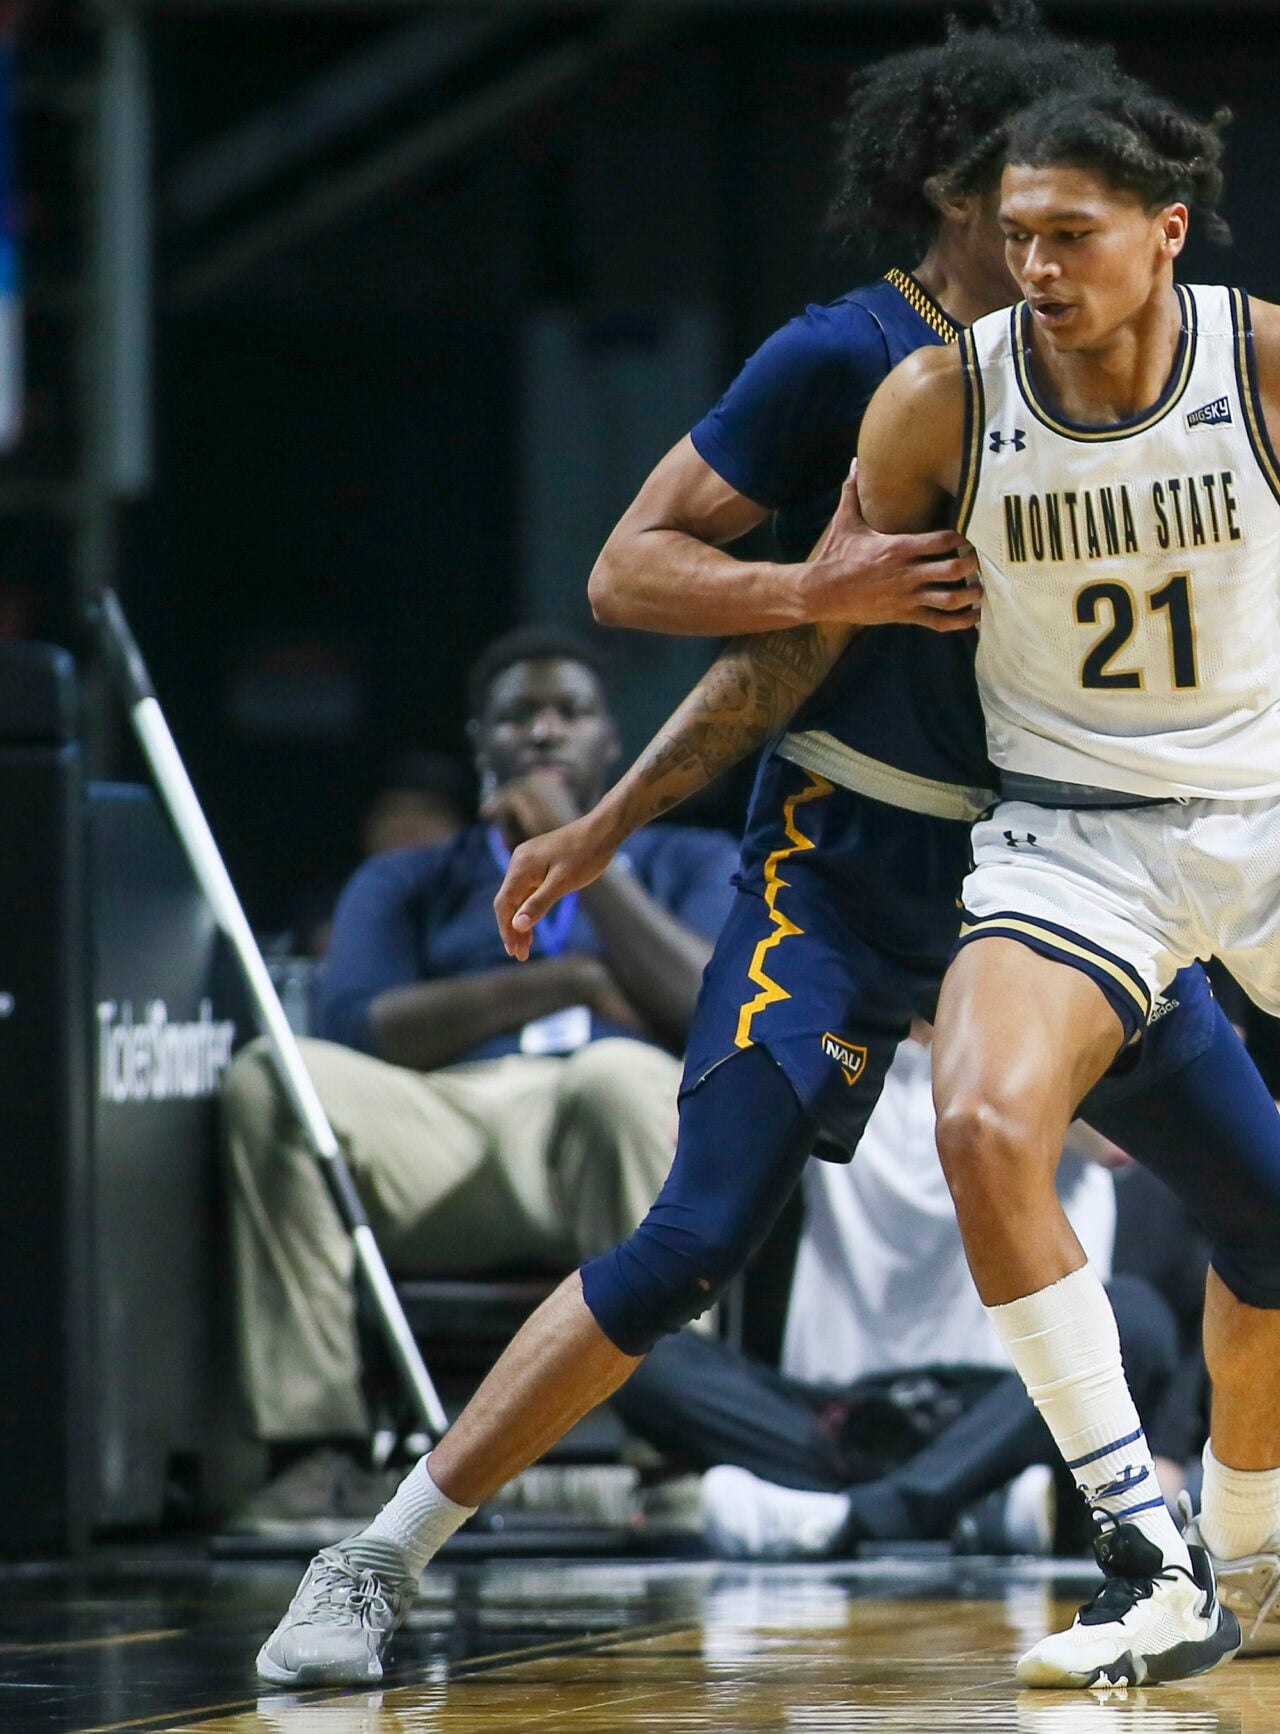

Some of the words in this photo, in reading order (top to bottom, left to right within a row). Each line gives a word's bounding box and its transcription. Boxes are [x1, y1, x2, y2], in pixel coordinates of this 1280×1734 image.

[1003, 484, 1140, 563] MONTANA
[1151, 470, 1243, 551] STATE
[1074, 570, 1200, 692] 21
[1149, 999, 1180, 1023] didas
[825, 1039, 862, 1072] NAU
